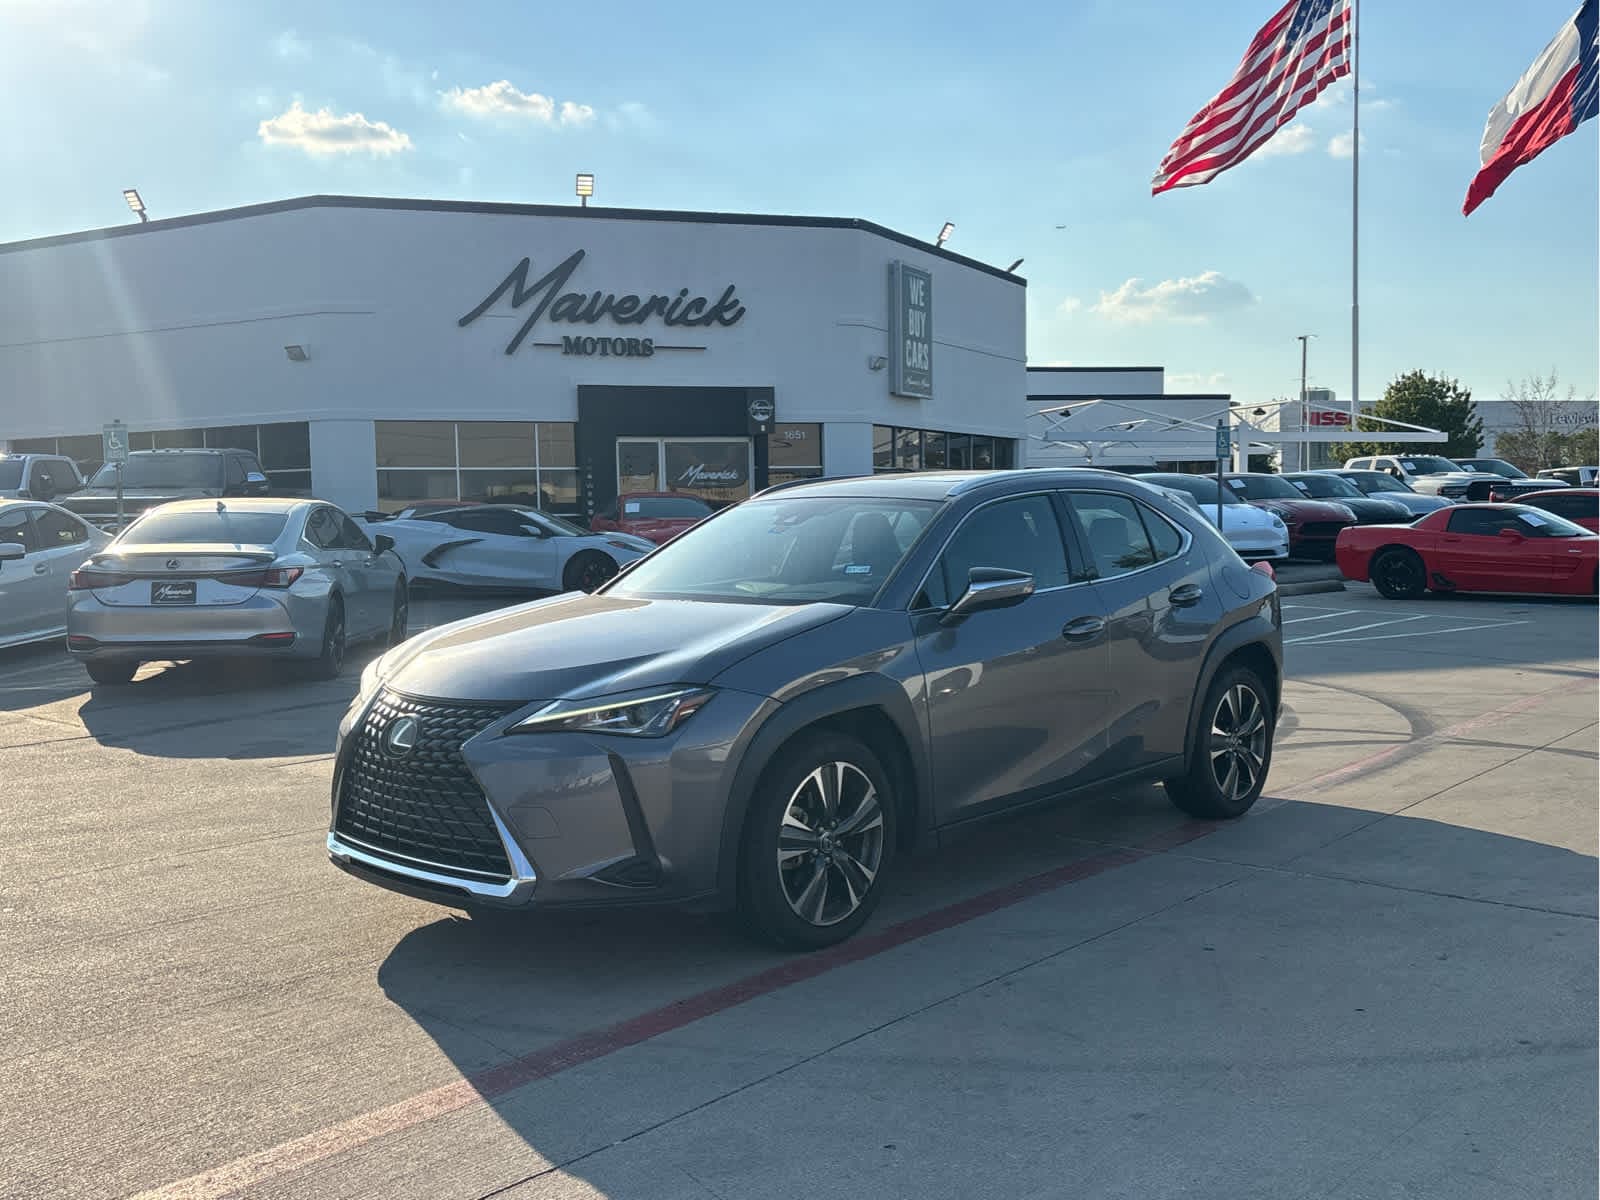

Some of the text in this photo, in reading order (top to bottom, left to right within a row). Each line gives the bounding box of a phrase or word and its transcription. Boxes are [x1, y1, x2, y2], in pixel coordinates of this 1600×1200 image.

[458, 249, 746, 355] Maverick
[909, 276, 925, 307] WE
[908, 308, 927, 338] BUY
[562, 335, 655, 357] MOTORS
[905, 339, 929, 371] CARS
[678, 463, 738, 487] Maverick
